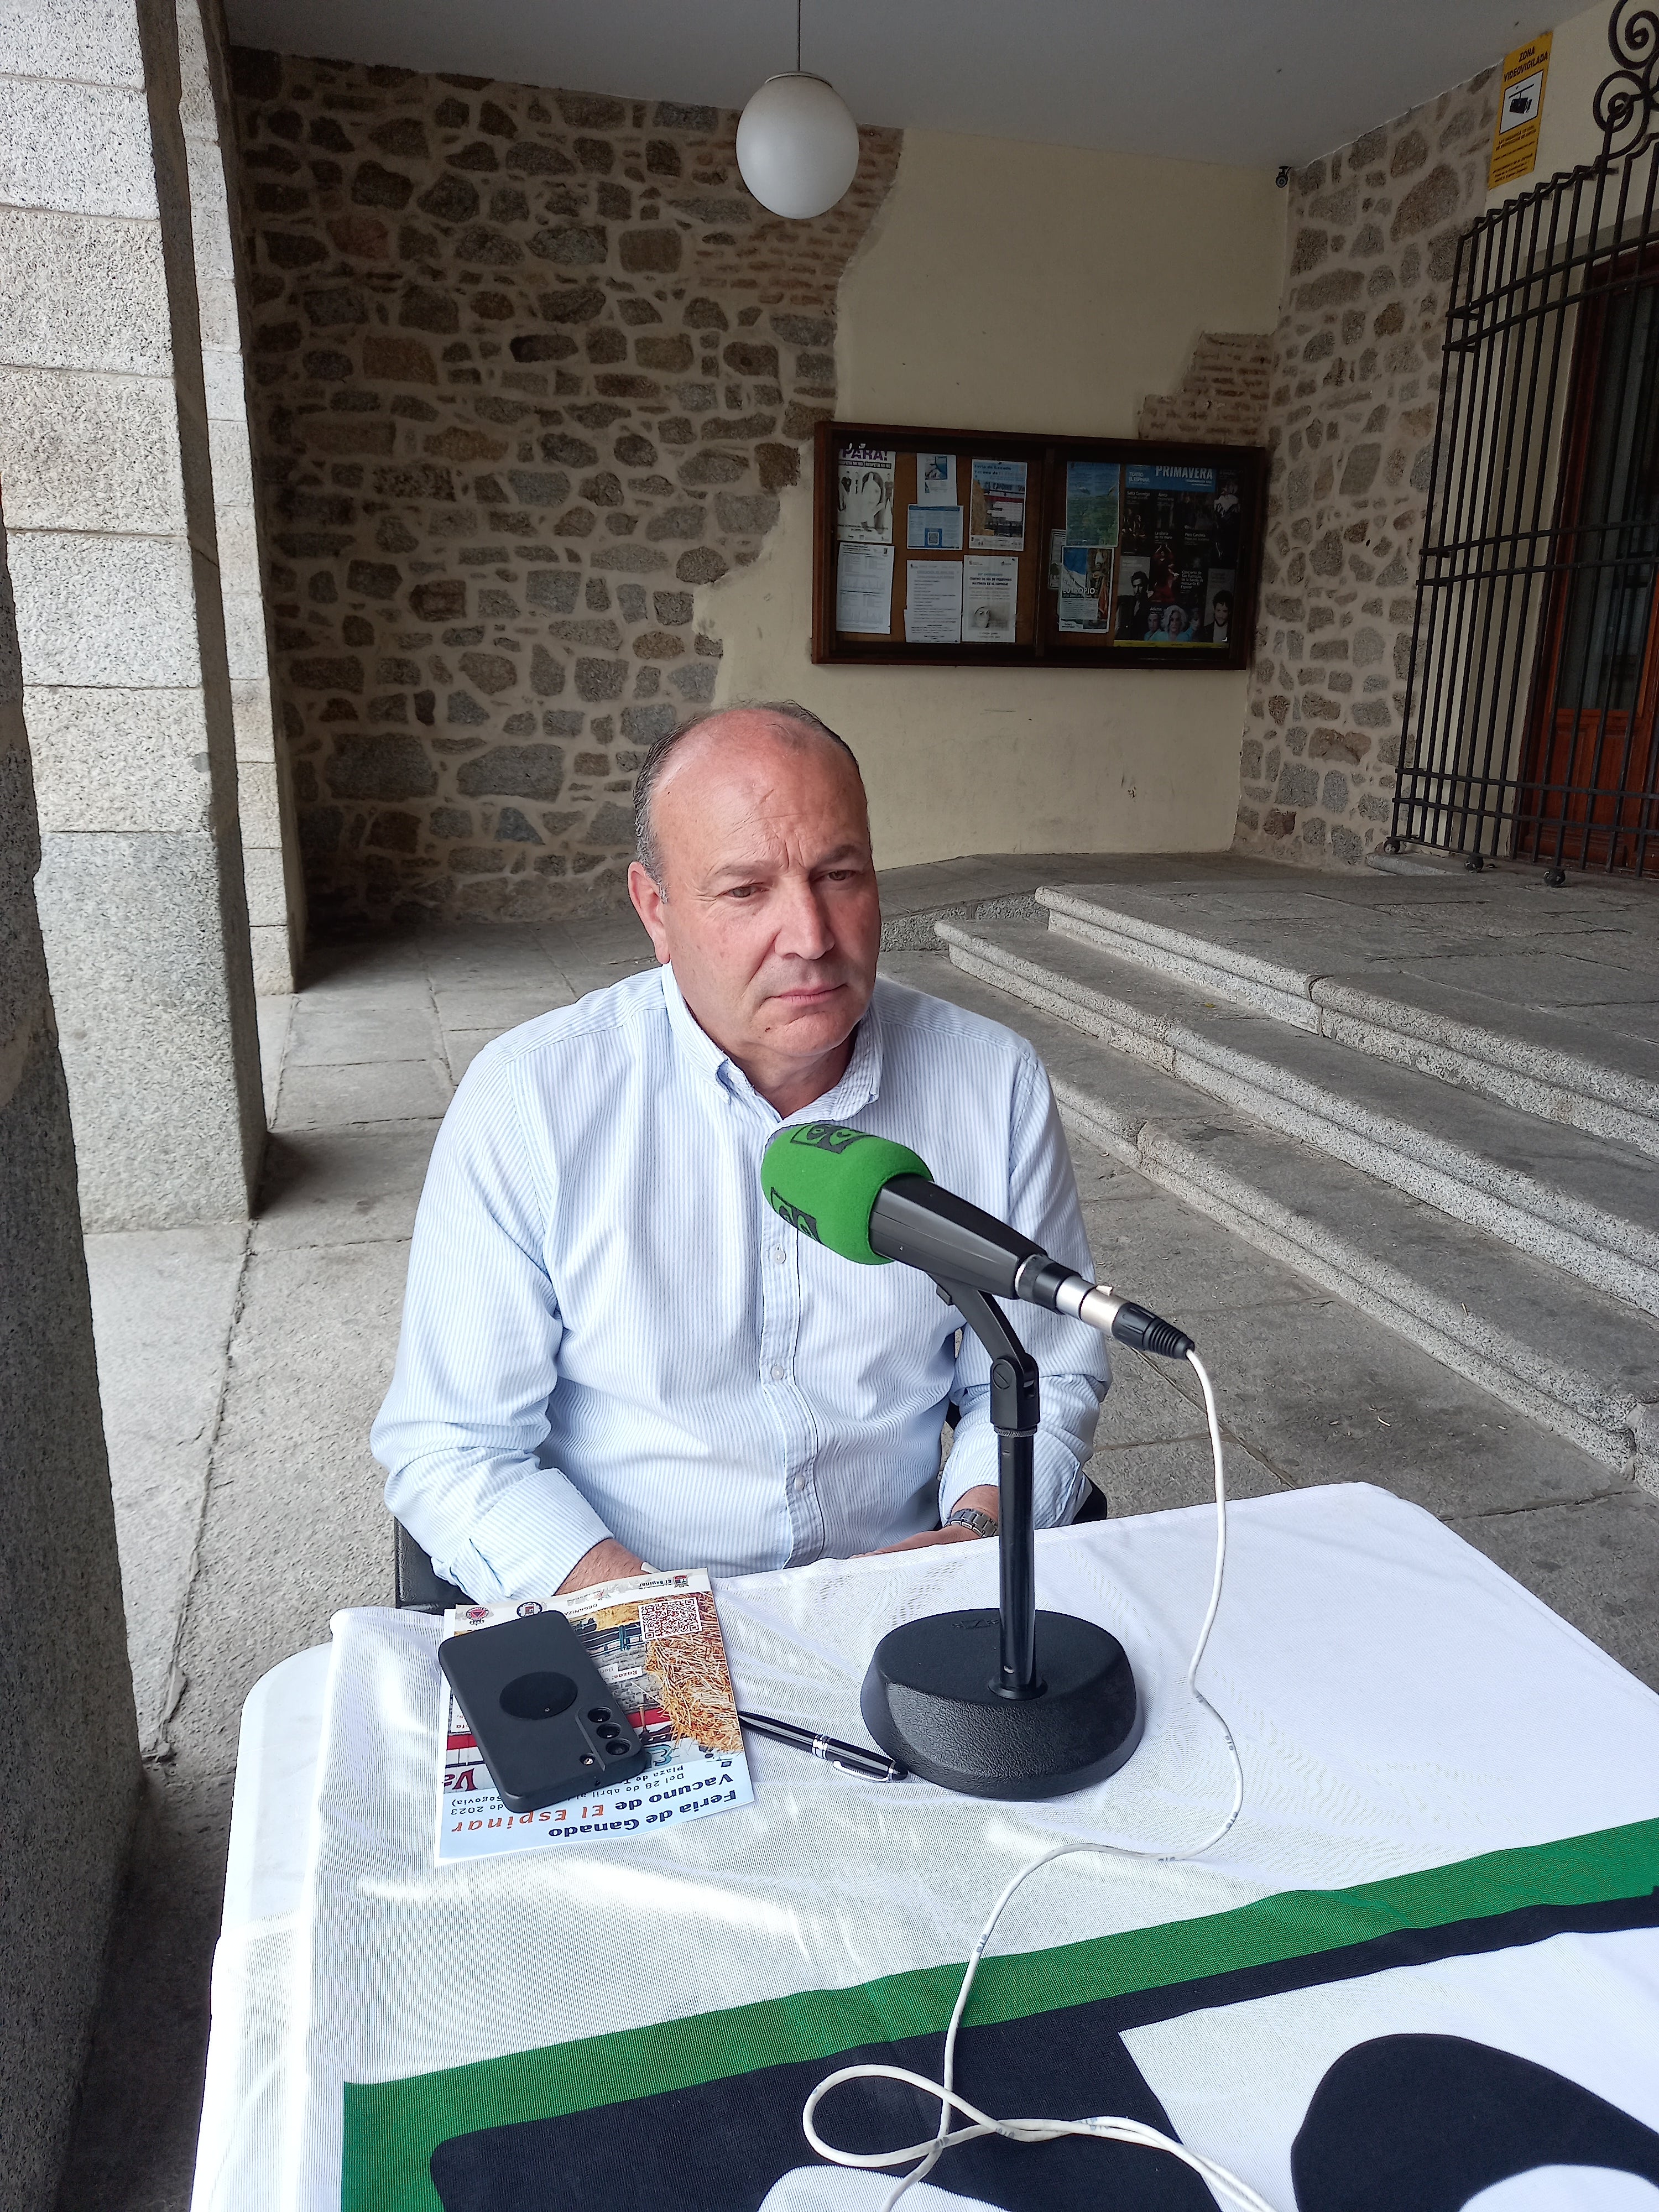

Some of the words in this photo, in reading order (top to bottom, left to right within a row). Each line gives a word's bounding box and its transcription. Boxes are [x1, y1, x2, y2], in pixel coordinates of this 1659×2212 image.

[1519, 45, 1535, 62] ZONA
[1504, 50, 1548, 82] VIDEOVIGILADA
[1155, 466, 1213, 479] PRIMAVERA
[564, 1604, 597, 1615] ORGANIZA
[653, 1765, 683, 1777] Plaza
[665, 1773, 684, 1783] Del
[645, 1780, 660, 1789] 28
[649, 1773, 733, 1803] Vacuno
[593, 1788, 620, 1798] abril
[615, 1799, 642, 1811] de
[680, 1790, 736, 1813] Feria
[451, 1806, 484, 1815] 2023
[582, 1805, 603, 1819] El
[451, 1809, 566, 1832] Espinar
[645, 1811, 672, 1823] de
[548, 1819, 639, 1838] Ganado
